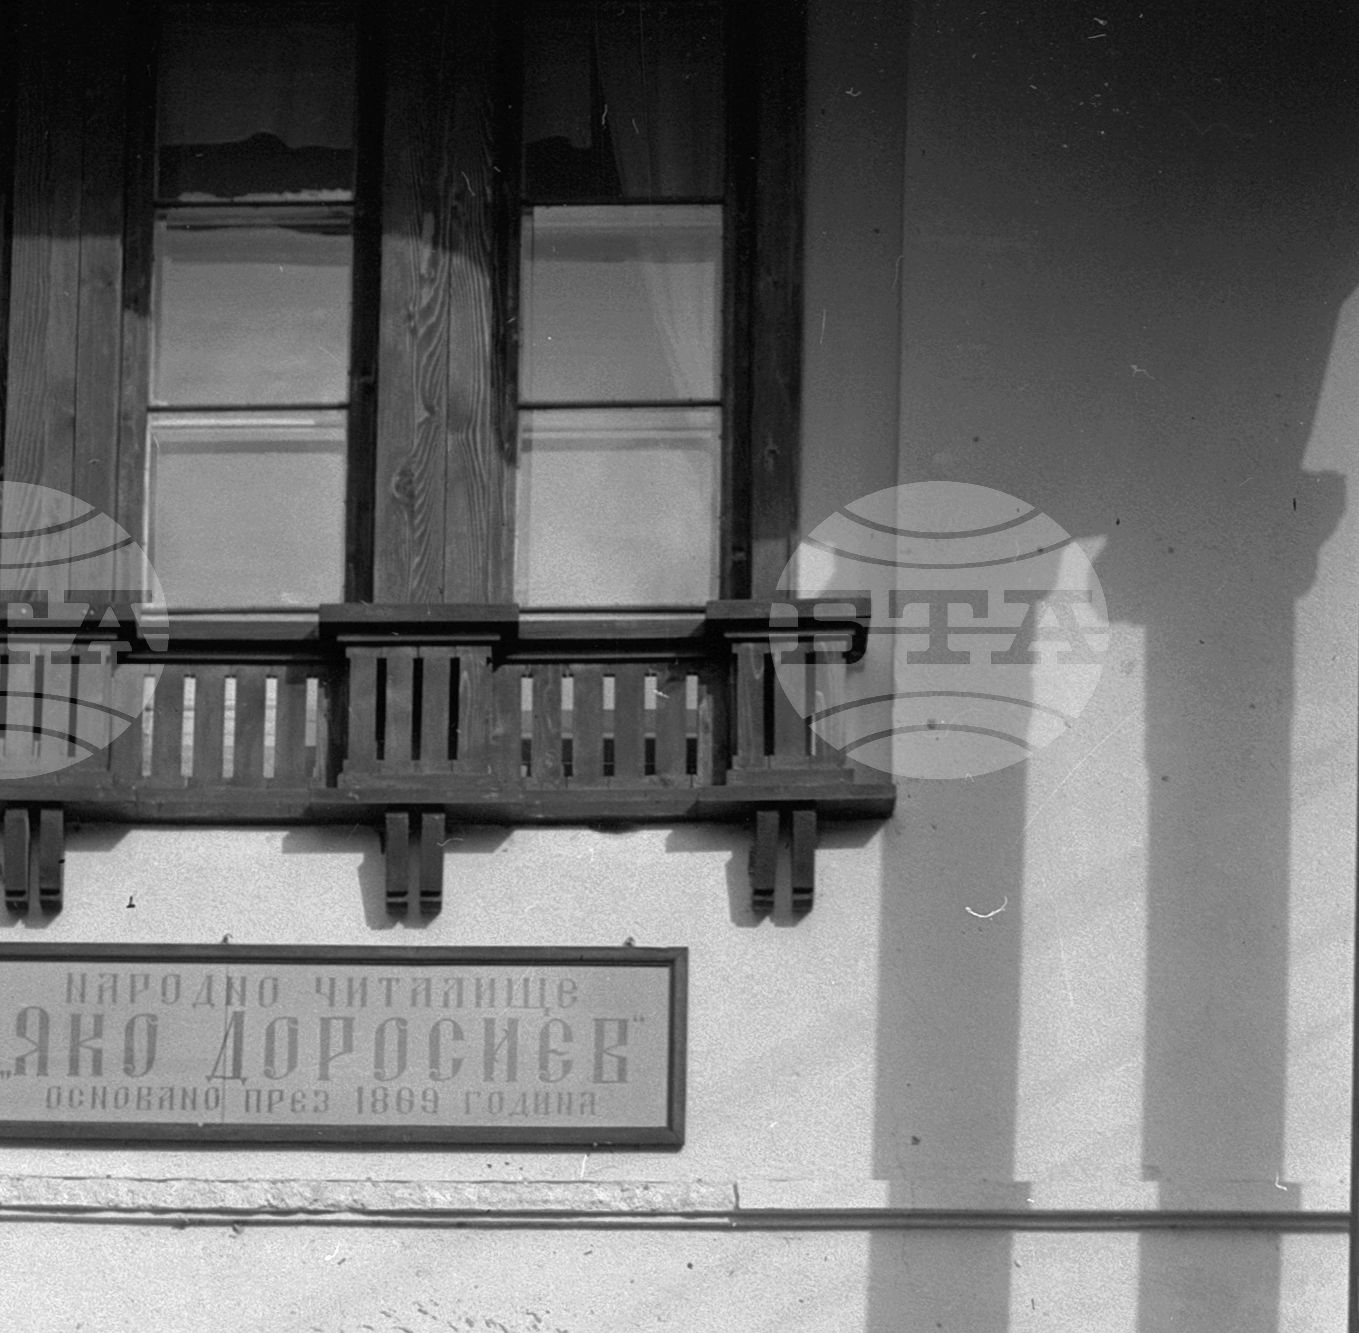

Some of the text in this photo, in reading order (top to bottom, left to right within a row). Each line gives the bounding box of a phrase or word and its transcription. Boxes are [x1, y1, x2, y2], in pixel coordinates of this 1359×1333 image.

[66, 972, 579, 1016] НАРОДНО ЧИТАЛИЩЕ
[46, 1085, 221, 1112] ОСНОВАНО
[244, 1088, 331, 1115] ПРЕЗ
[464, 1089, 597, 1118] ГОДИНА
